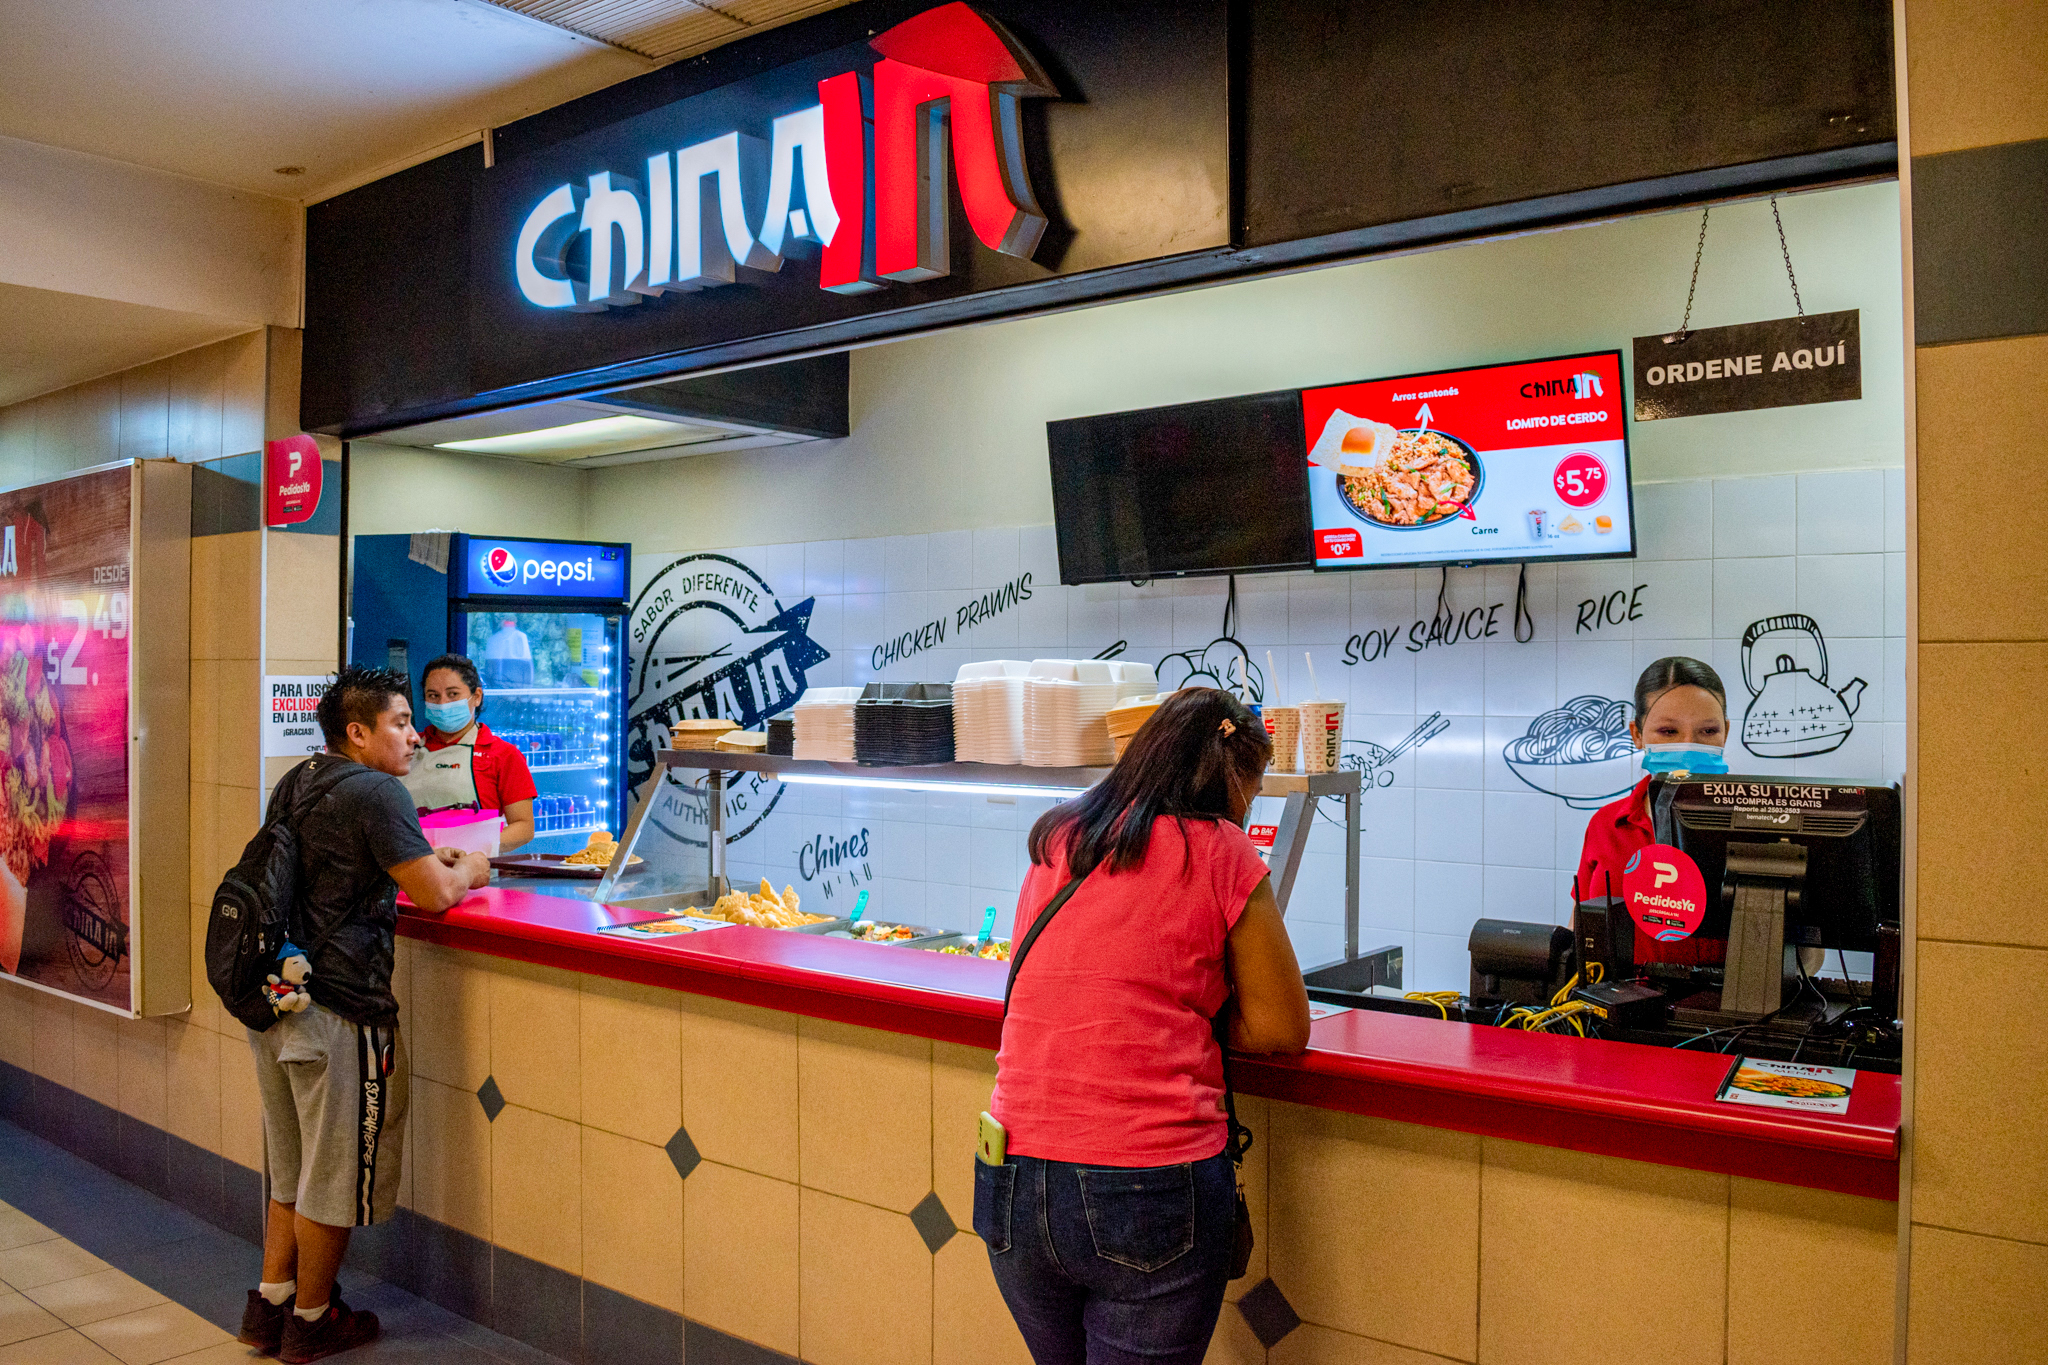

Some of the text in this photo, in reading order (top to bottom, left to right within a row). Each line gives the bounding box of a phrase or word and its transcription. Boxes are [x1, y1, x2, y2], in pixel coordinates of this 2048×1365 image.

[1646, 340, 1846, 386] ORDENE AQUÍ
[1392, 386, 1459, 402] Arroz cantonés
[1506, 411, 1608, 430] LOMITO DE CERDO
[279, 481, 310, 496] PedidosYa
[1471, 526, 1499, 535] Carne
[94, 565, 126, 584] DESDE
[523, 557, 593, 586] pepsi
[633, 573, 759, 643] SABOR DIFERENTE
[1576, 584, 1648, 635] RICE
[872, 572, 1033, 671] CHICKEN PRAWNS
[1341, 603, 1504, 666] SOY SAUCE
[272, 684, 303, 697] PARA
[272, 698, 321, 711] EXCLUSIV
[273, 712, 318, 723] EN LA BAR
[283, 728, 314, 737] ¡GRACIAS!
[1703, 783, 1832, 800] EXIJA SU TICKET
[1713, 796, 1823, 808] O SU COMPRA ES GRATIS
[1734, 805, 1759, 814] Reporte
[1746, 813, 1774, 821] bematech
[1260, 827, 1274, 835] BAC
[799, 827, 870, 881] Chines
[1633, 892, 1696, 912] PedidosYa
[362, 1081, 380, 1166] SOMEWHERE
